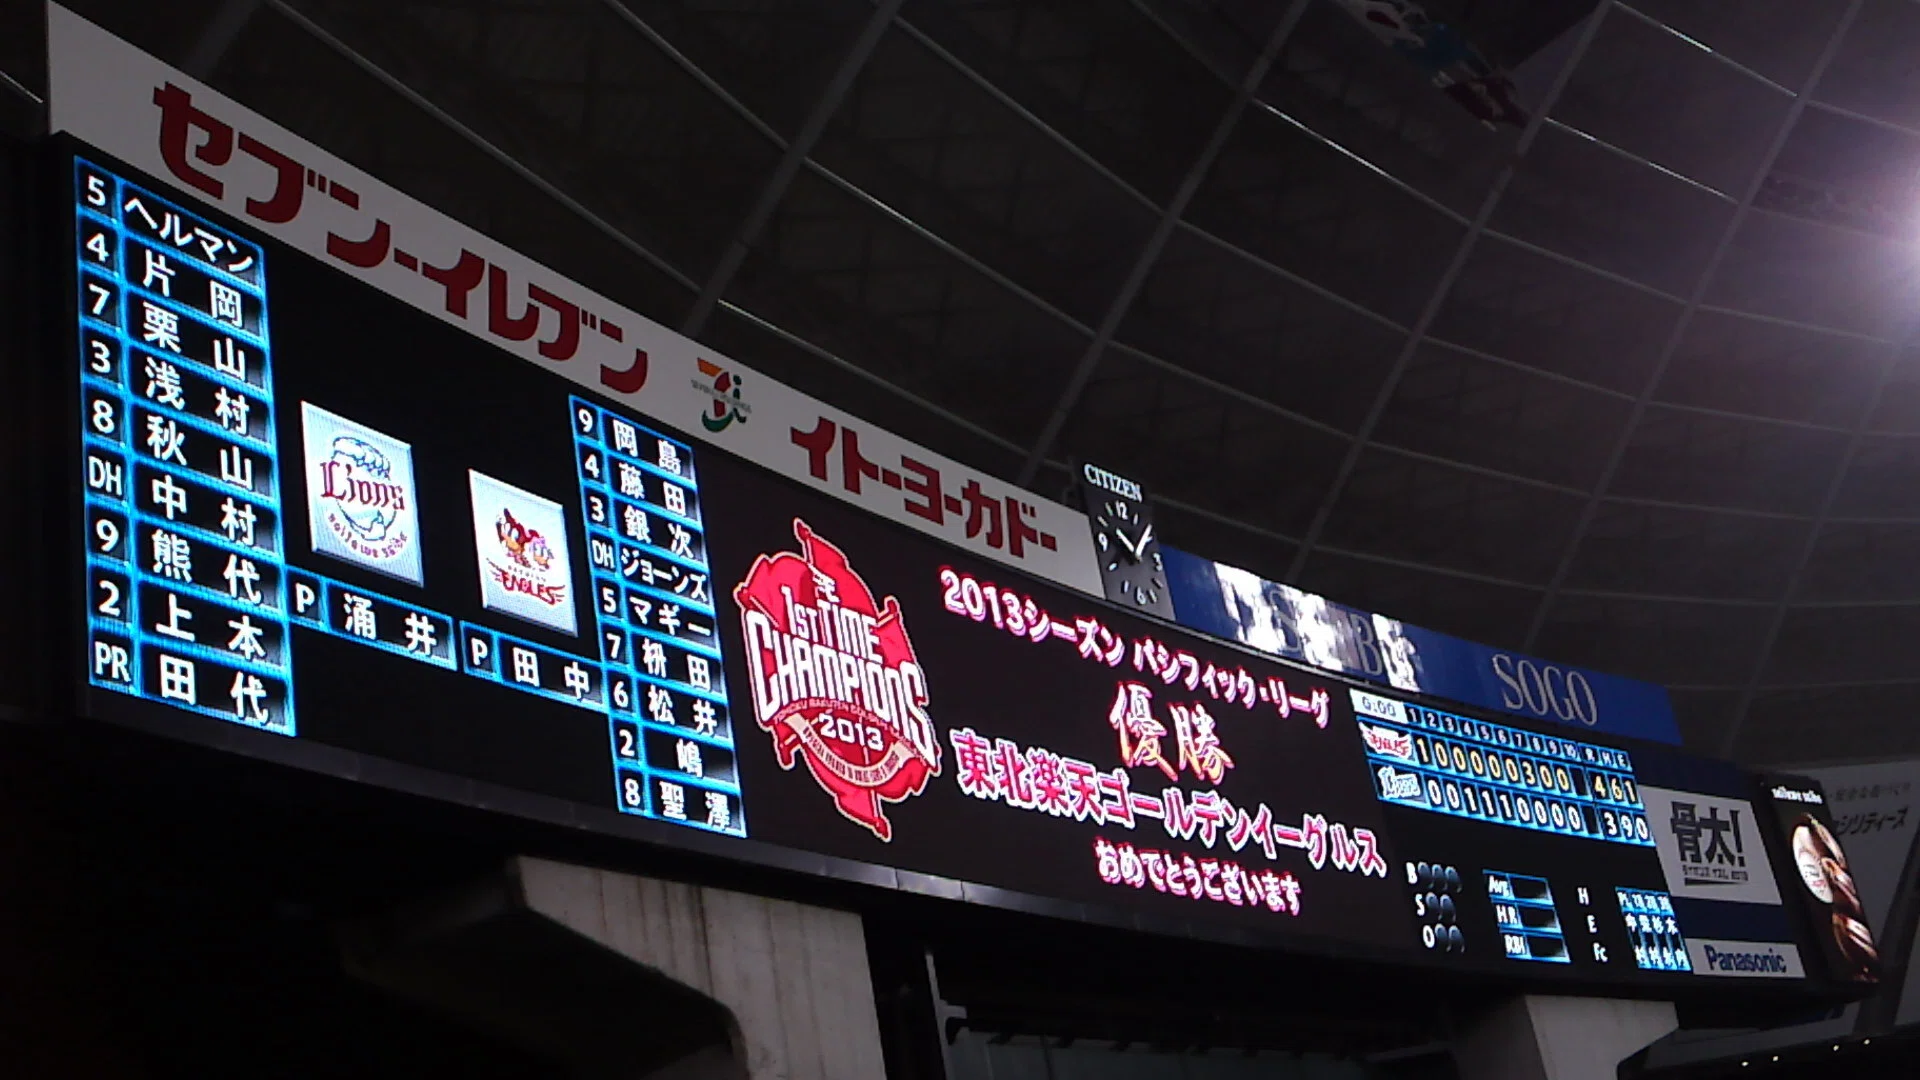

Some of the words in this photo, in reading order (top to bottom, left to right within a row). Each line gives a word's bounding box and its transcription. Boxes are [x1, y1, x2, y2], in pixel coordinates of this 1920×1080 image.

[88, 175, 106, 206] 5
[124, 198, 253, 272] ヘルマン
[87, 233, 109, 262] 4
[88, 283, 110, 315] 7
[91, 340, 111, 373] 3
[92, 399, 115, 434] 8
[579, 408, 593, 432] 9
[88, 455, 122, 496] DH
[585, 454, 599, 478] 4
[1084, 463, 1143, 503] CITIZEN
[320, 460, 405, 511] Lions
[790, 416, 1058, 558] イトーヨーカドー
[590, 496, 604, 521] 3
[1115, 500, 1128, 520] 12
[96, 519, 119, 552] 9
[1098, 532, 1108, 552] 9
[1153, 552, 1163, 571] 3
[592, 539, 615, 570] DH
[620, 548, 709, 602] ジョーンズ
[98, 580, 120, 617] 2
[296, 582, 315, 613] P
[602, 587, 617, 613] 5
[629, 595, 711, 636] マギー
[1135, 586, 1147, 605] 6
[781, 585, 818, 642] 1ST
[816, 598, 883, 665] TIME
[940, 567, 1126, 668] 2013シーズン
[95, 641, 129, 684] PR
[471, 637, 488, 666] P
[606, 633, 621, 659] 7
[612, 681, 628, 707] 6
[745, 609, 937, 769] CHAMPIONS
[1492, 653, 1599, 727] SOGO
[618, 729, 634, 757] 2
[818, 713, 884, 751] 2013
[1108, 682, 1235, 785] 優勝
[1417, 738, 1429, 763] 1
[1435, 742, 1448, 767] 0
[1452, 746, 1466, 771] 0
[1470, 750, 1484, 775] 0
[1488, 754, 1501, 778] 0
[1505, 758, 1519, 782] 0
[1522, 761, 1536, 785] 3
[1539, 765, 1553, 788] 0
[1556, 768, 1570, 791] 0
[1594, 775, 1606, 797] 4
[1611, 778, 1623, 800] 6
[1625, 780, 1636, 802] 1
[624, 778, 641, 806] 8
[950, 727, 1387, 878] 東北楽天ゴールデンイーグルス
[1428, 780, 1442, 805] 0
[1446, 783, 1460, 809] 0
[1464, 787, 1477, 812] 1
[1481, 790, 1495, 816] 1
[1500, 794, 1512, 818] 1
[1516, 797, 1531, 822] 0
[1534, 800, 1548, 825] 0
[1551, 803, 1565, 828] 0
[1568, 806, 1581, 830] 0
[1604, 811, 1618, 836] 3
[1620, 815, 1633, 838] 9
[1635, 817, 1649, 841] 0
[1093, 837, 1302, 916] おめでとうございます
[1406, 861, 1418, 884] B
[1415, 893, 1425, 916] S
[1577, 887, 1590, 905] H
[1586, 915, 1598, 933] E
[1703, 944, 1787, 974] Panasonic
